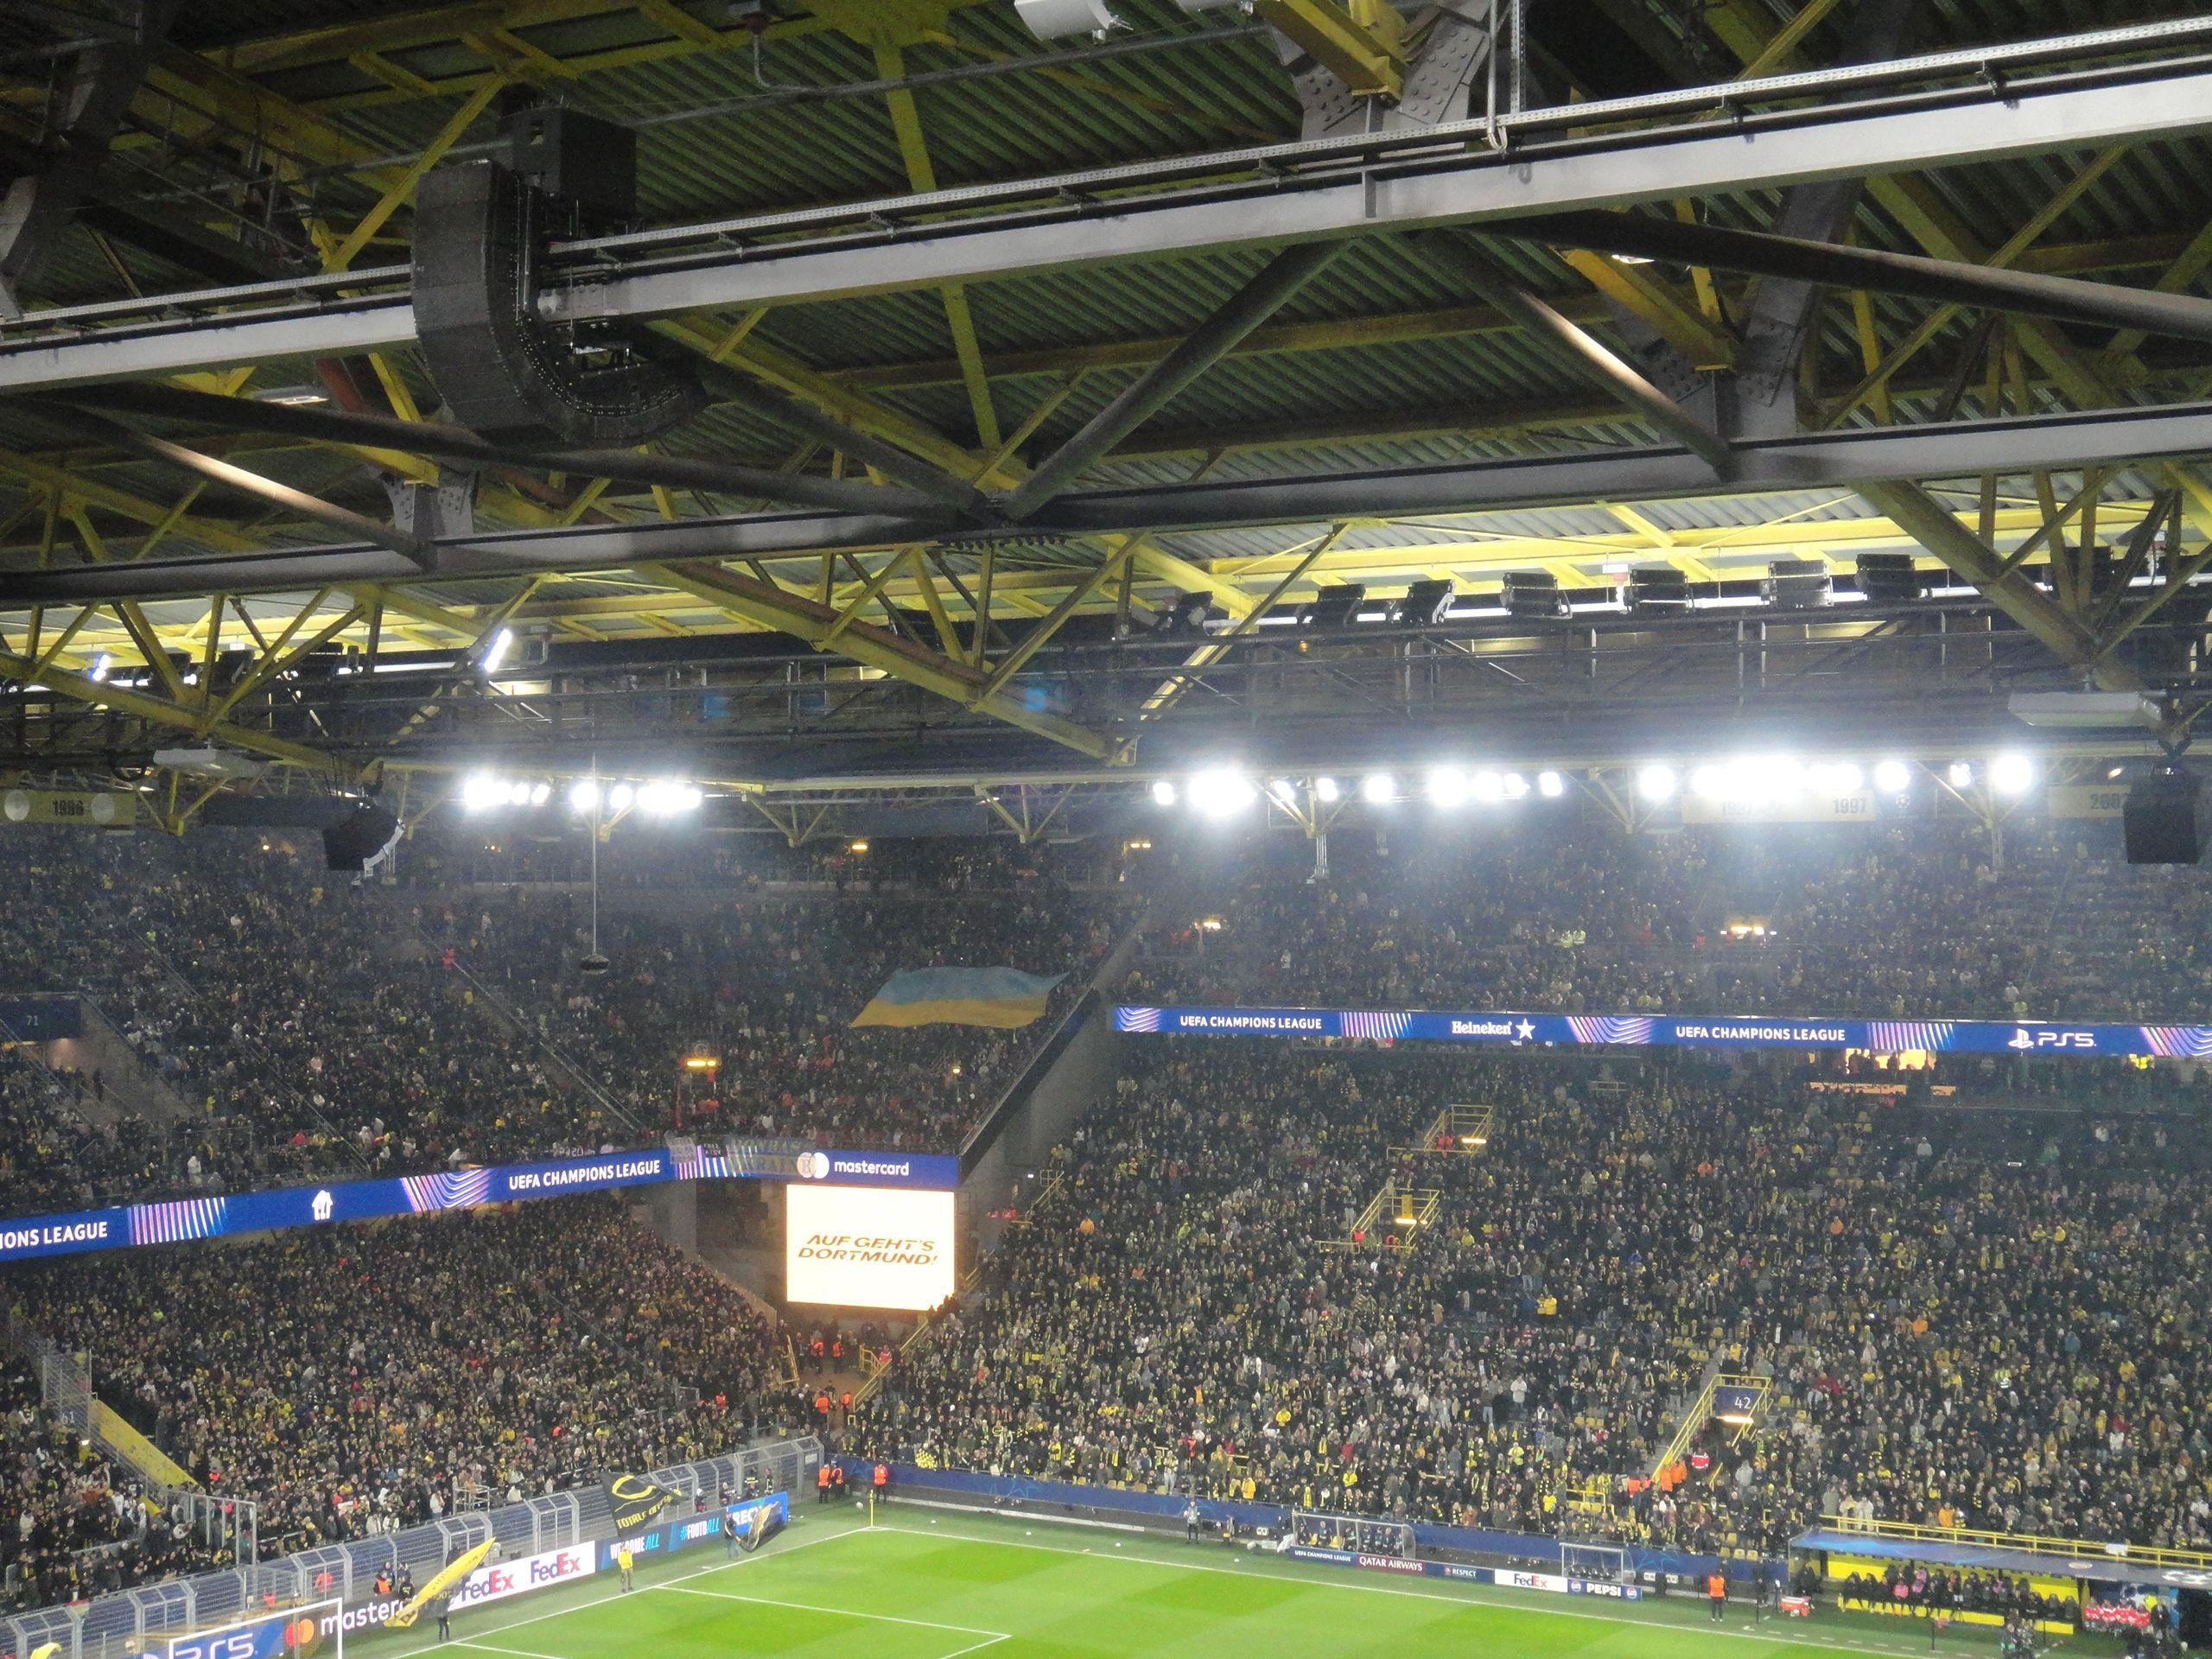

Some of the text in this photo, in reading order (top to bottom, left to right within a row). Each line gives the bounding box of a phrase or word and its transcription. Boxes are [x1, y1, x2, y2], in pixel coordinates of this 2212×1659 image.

[1834, 798, 1867, 814] 1997
[1180, 1015, 1322, 1029] UEFA CHAMPIONS LEAGUE
[1452, 1021, 1511, 1035] Heineken
[1675, 1026, 1846, 1041] UEFA CHAMPIONS LEAGUE
[2037, 1032, 2094, 1047] PS5
[509, 1160, 661, 1191] UEFA CHAMPIONS LEAGUE
[834, 1160, 910, 1176] mastercard
[43, 1221, 108, 1244] LEAGUE
[806, 1234, 936, 1252] AUF GEHT'S
[798, 1248, 938, 1266] DORTMUND!
[1734, 1395, 1751, 1409] 42
[645, 1533, 660, 1551] ALL
[1306, 1551, 1333, 1560] CHAMPIONS
[531, 1552, 581, 1584] FedEx
[1359, 1556, 1423, 1572] QATAR AIRWAYS
[1452, 1567, 1477, 1577] RESPECT
[1514, 1573, 1548, 1588] FedEx
[1586, 1582, 1622, 1598] PEPSI
[321, 1599, 404, 1630] master
